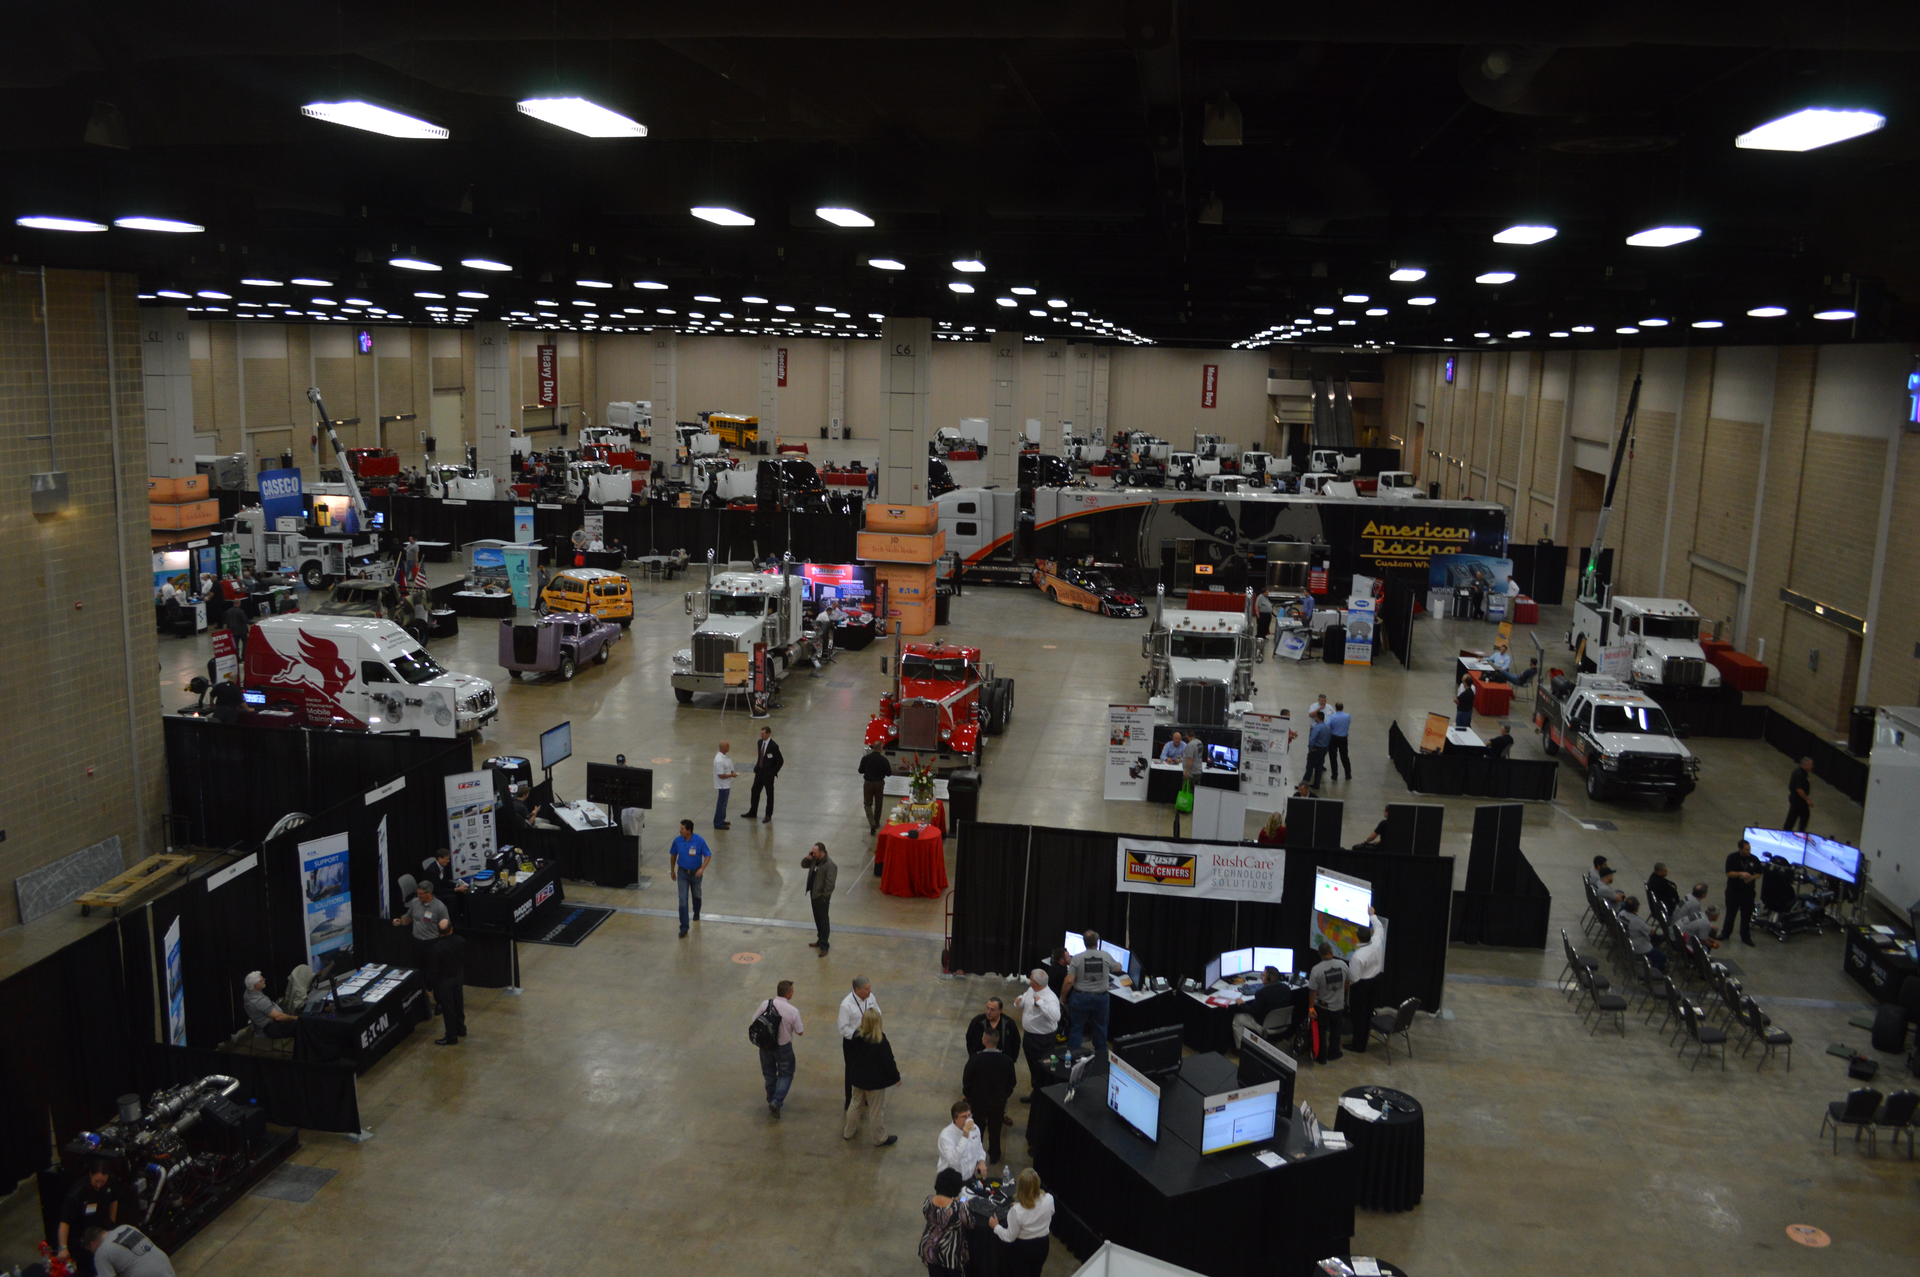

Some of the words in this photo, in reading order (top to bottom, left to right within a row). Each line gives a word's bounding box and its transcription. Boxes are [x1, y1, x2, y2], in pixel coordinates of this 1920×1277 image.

[896, 344, 910, 354] C6
[1000, 348, 1010, 356] C7
[541, 349, 553, 378] Heavy
[778, 350, 786, 380] Specialty
[1206, 367, 1215, 391] Medium
[542, 381, 554, 402] Duty
[1204, 392, 1214, 406] Duty
[262, 476, 299, 496] CASECO
[1362, 520, 1470, 538] American
[1375, 559, 1412, 568] Custom
[314, 855, 339, 867] SUPPORT
[1212, 854, 1274, 870] RushCare
[1131, 864, 1155, 875] TRUCK
[1156, 866, 1190, 878] CENTERS
[1213, 868, 1274, 880] TECHNOLOGY
[1211, 879, 1273, 890] SOLUTIONS
[314, 896, 344, 910] SOLUTIONS
